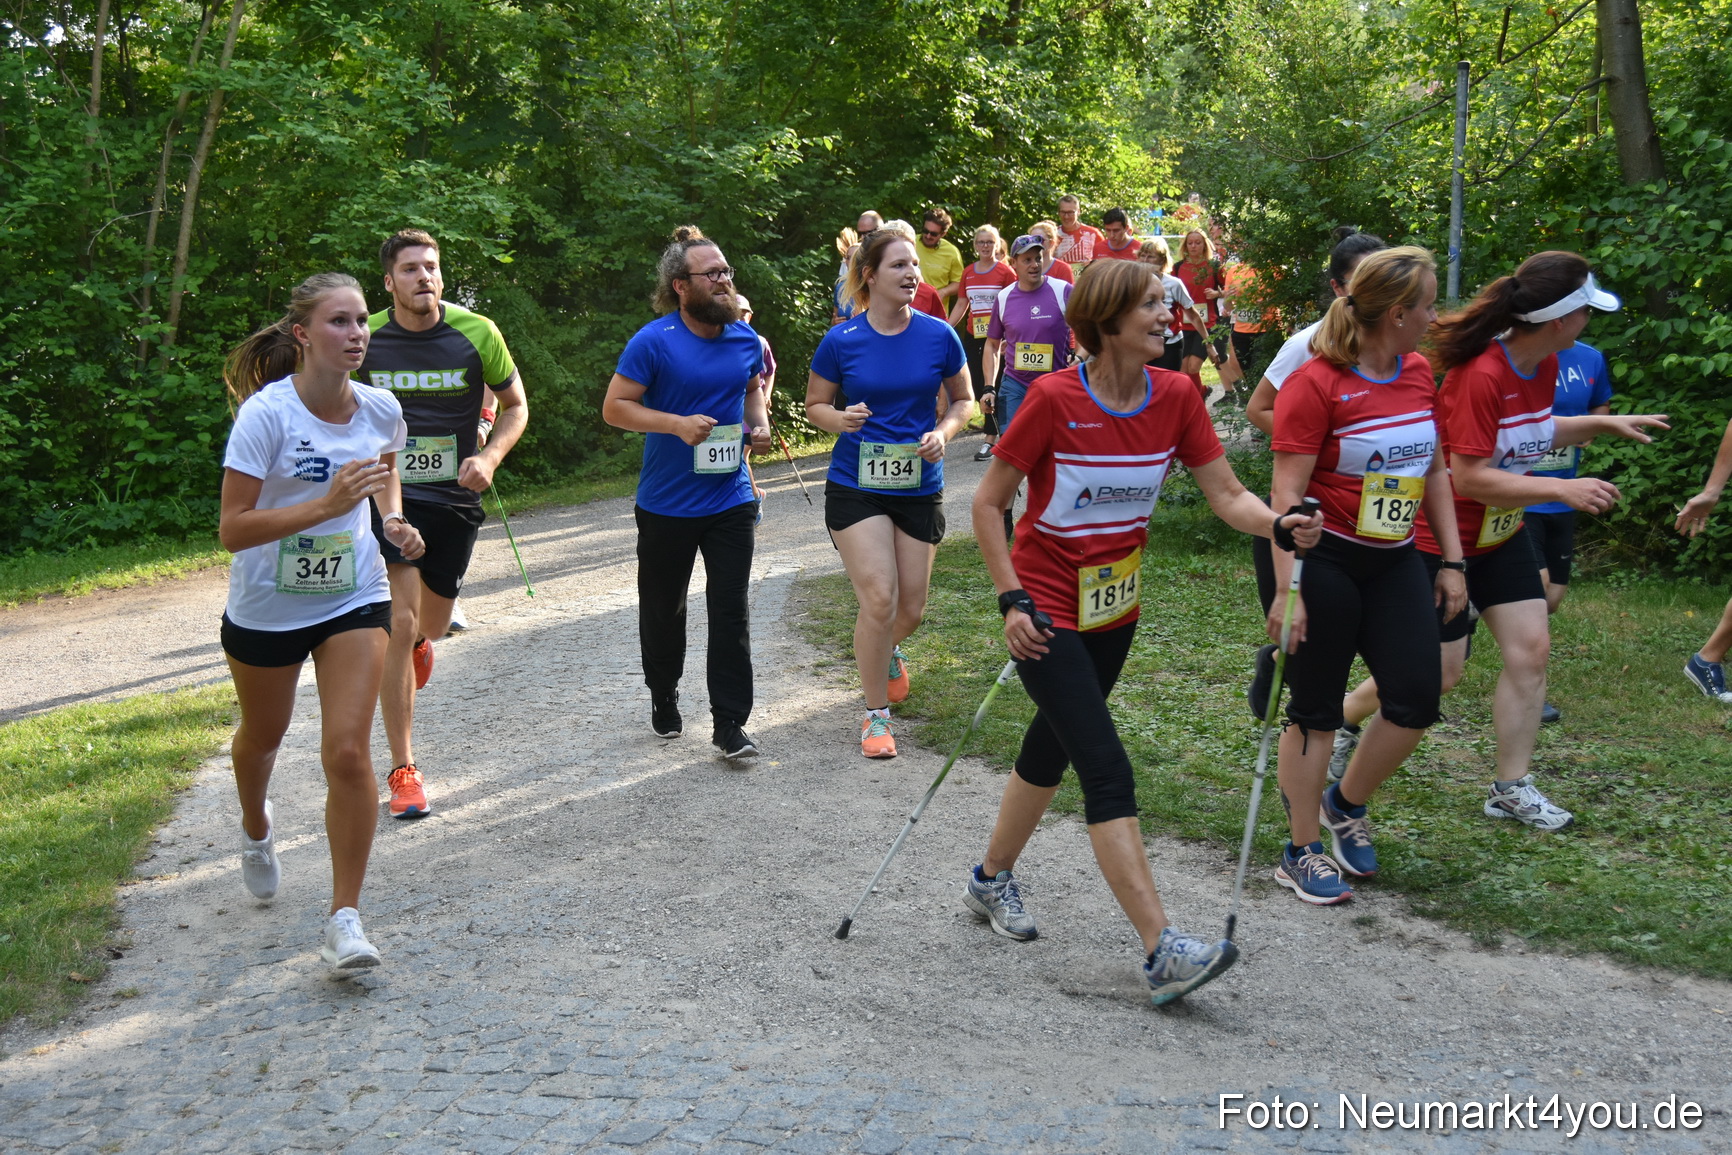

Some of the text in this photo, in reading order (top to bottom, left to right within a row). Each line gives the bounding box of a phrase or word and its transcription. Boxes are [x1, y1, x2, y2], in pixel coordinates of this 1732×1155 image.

[1023, 353, 1044, 364] 902
[371, 371, 465, 389] BOCK
[405, 454, 442, 470] 298
[709, 446, 736, 462] 9111
[868, 460, 914, 476] 1134
[1097, 485, 1159, 498] Petry
[296, 556, 342, 579] 347
[1091, 573, 1136, 610] 1814
